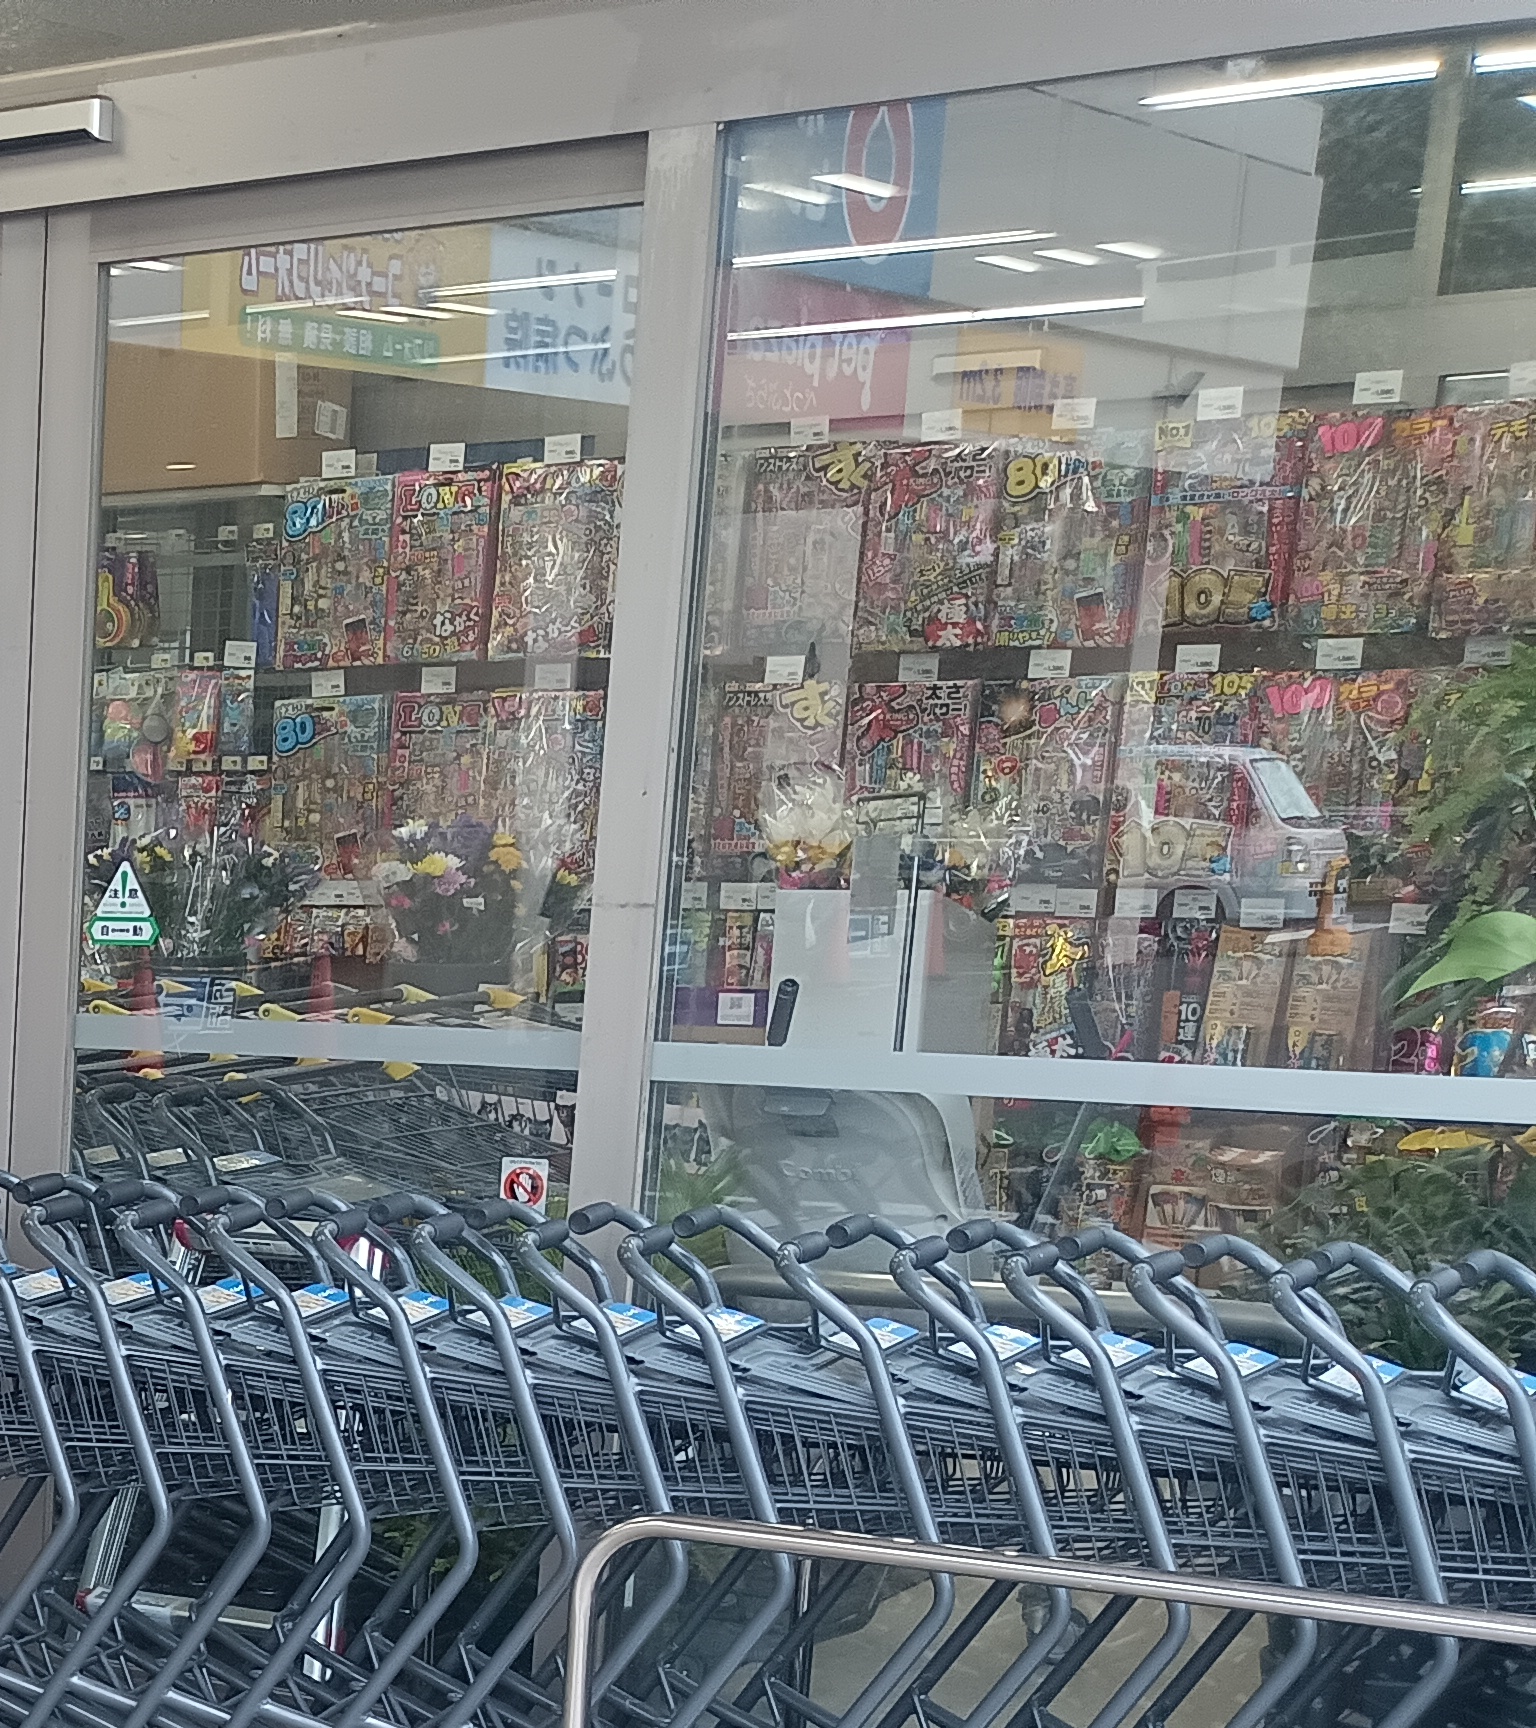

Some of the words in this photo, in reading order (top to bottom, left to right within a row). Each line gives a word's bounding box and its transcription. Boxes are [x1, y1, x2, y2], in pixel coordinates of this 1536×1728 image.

[398, 702, 484, 729] LONG
[275, 714, 316, 752] 80
[108, 888, 139, 900] 注意
[1179, 1002, 1201, 1021] 10
